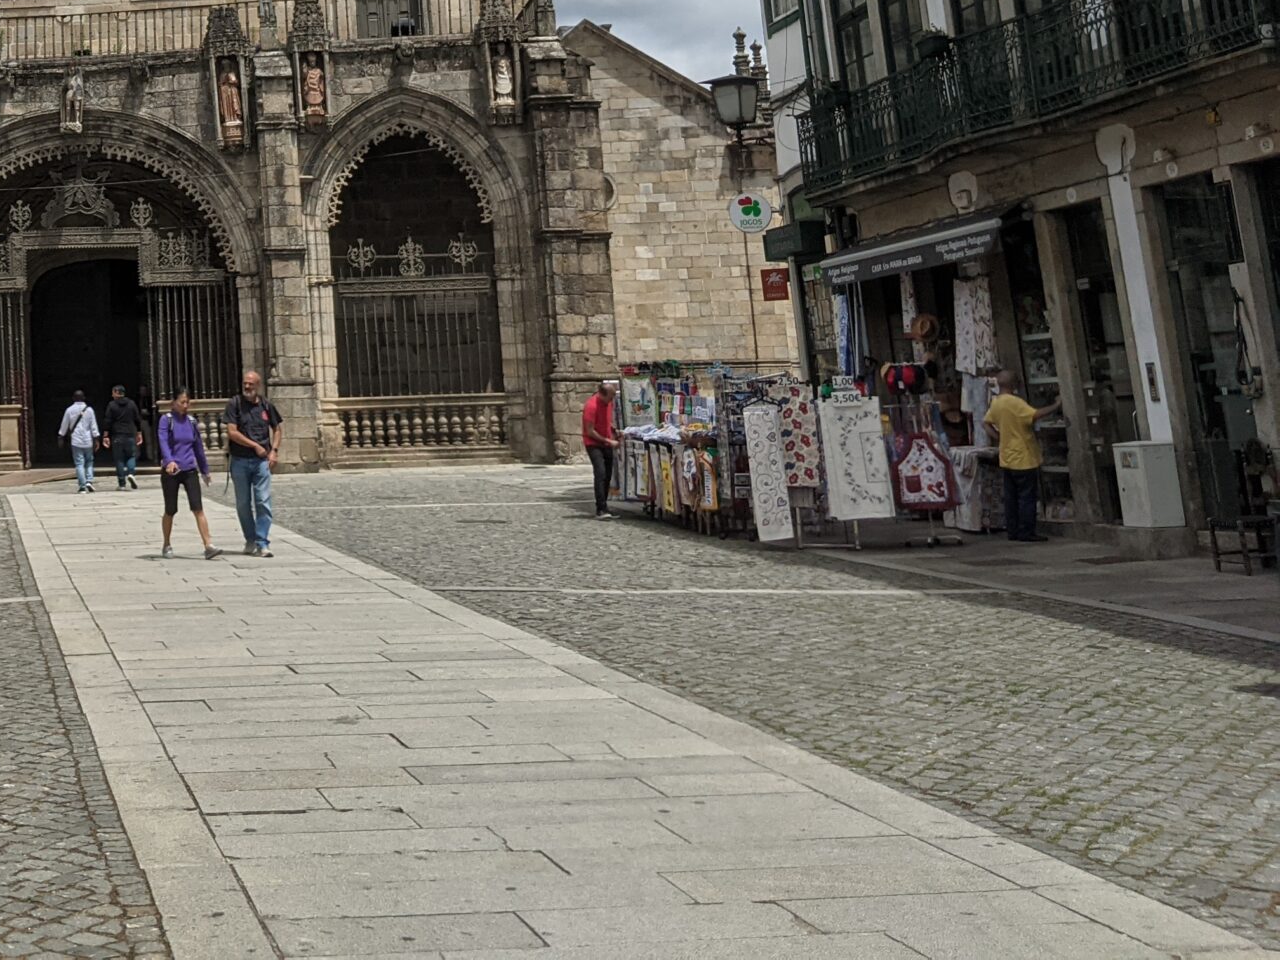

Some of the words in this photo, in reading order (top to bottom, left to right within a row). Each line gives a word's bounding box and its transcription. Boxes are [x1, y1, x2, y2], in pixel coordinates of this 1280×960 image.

[740, 218, 763, 227] JOGOS
[778, 377, 799, 386] 2,50
[833, 378, 853, 386] 1,00
[833, 393, 861, 404] 3,50€
